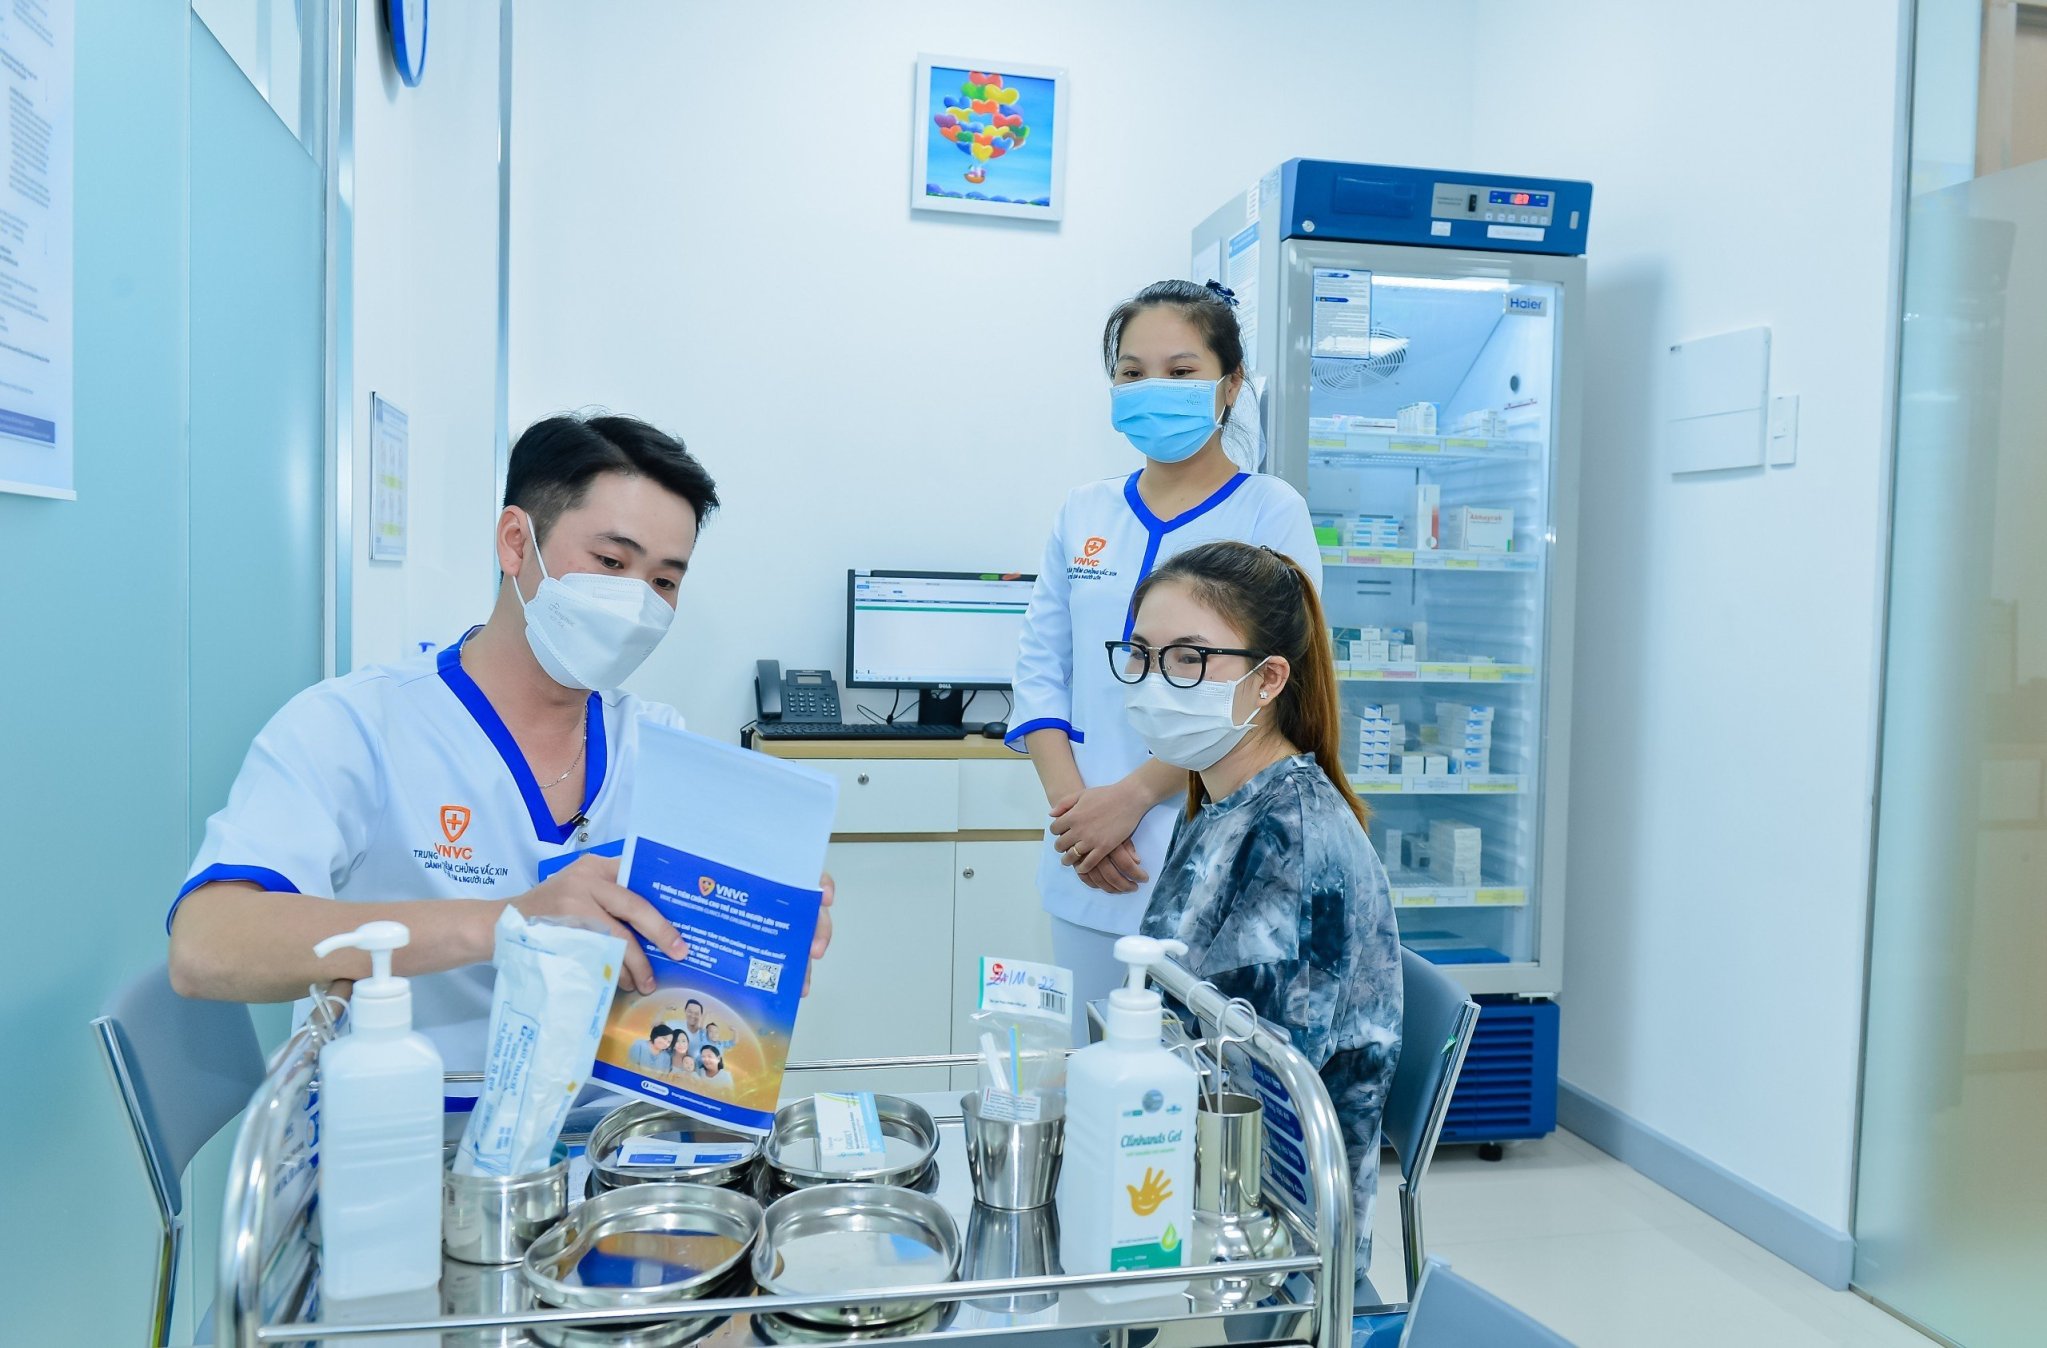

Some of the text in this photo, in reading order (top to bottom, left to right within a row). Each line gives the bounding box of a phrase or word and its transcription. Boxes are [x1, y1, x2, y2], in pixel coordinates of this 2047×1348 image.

[1510, 298, 1541, 309] Haier
[1073, 557, 1100, 567] VNVC
[434, 843, 472, 860] VNVC
[413, 850, 438, 860] TRUNG
[454, 862, 479, 875] CHỦNG
[480, 863, 495, 876] VẮC
[495, 867, 508, 876] XIN
[424, 860, 441, 869] DÀNH
[462, 875, 482, 884] NGƯỜI
[483, 877, 495, 885] LỚN
[717, 884, 749, 901] VNVC
[1120, 1129, 1183, 1148] Clinhands Gel
